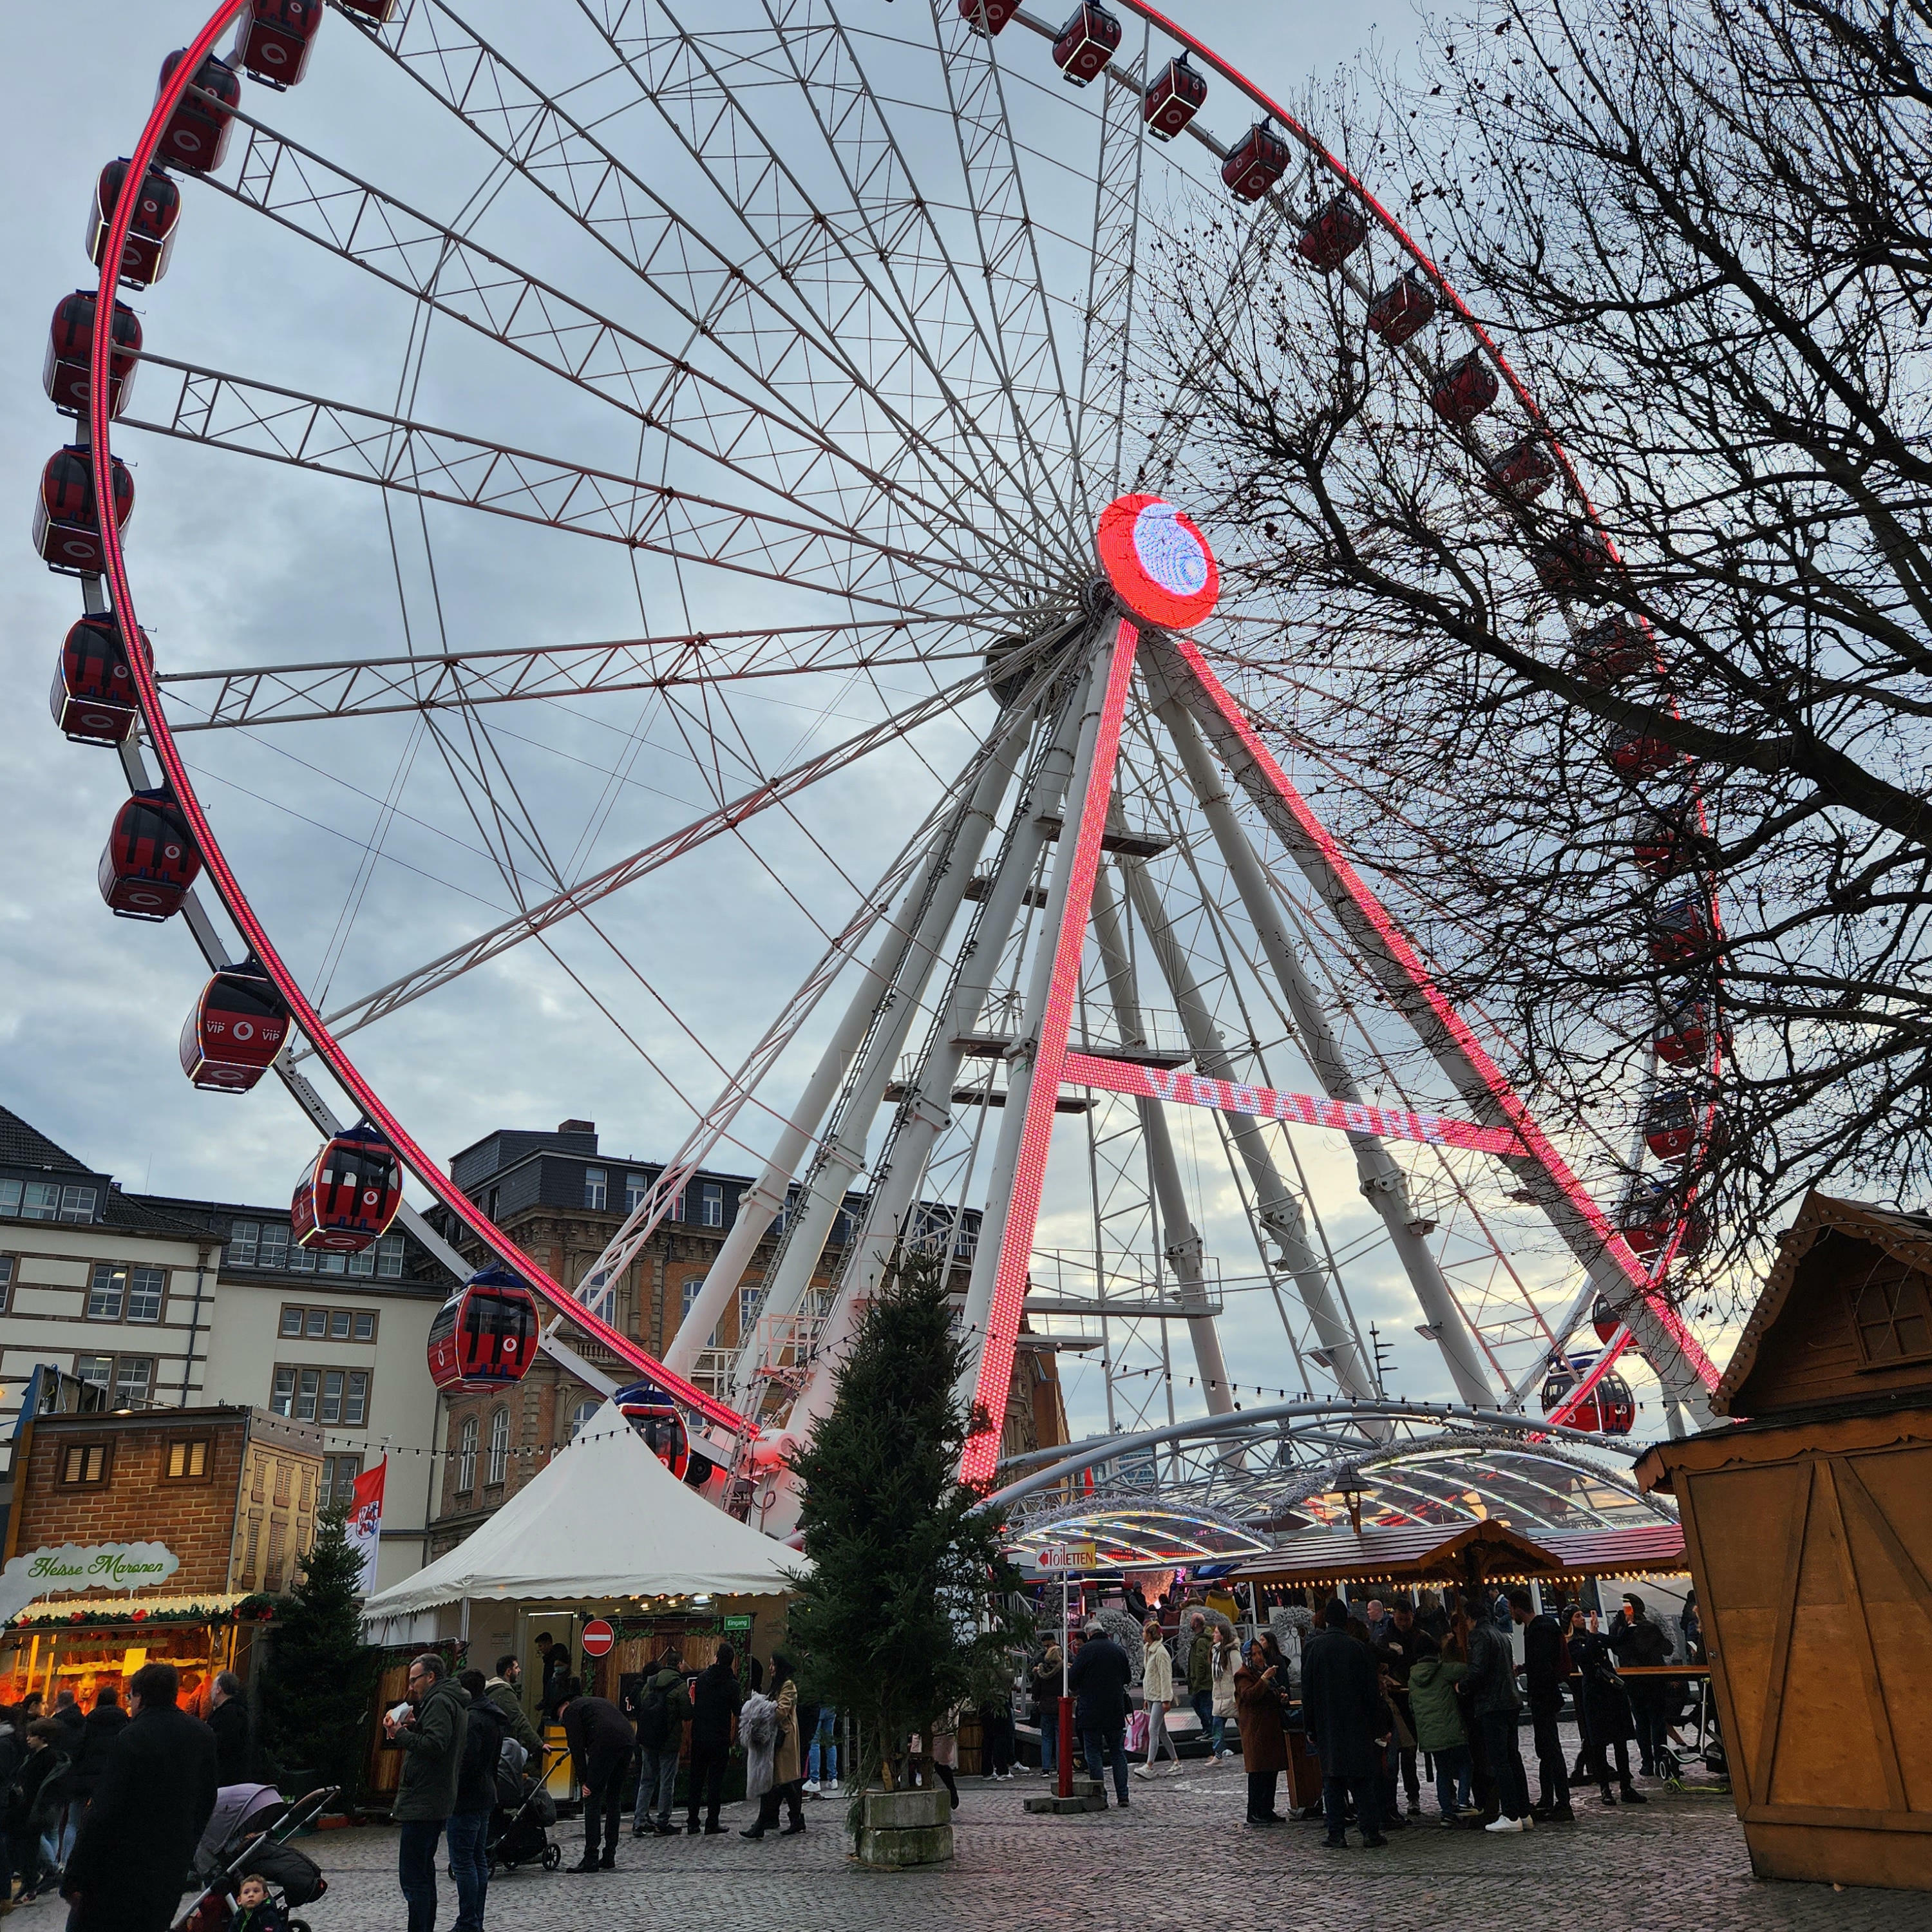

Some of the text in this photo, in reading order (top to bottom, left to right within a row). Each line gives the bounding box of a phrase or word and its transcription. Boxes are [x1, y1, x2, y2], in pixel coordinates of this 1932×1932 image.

[207, 1023, 225, 1034] VIP
[262, 1031, 279, 1041] VIP
[1144, 1066, 1446, 1146] VODAFONE
[28, 1553, 164, 1582] Heisse Maronen
